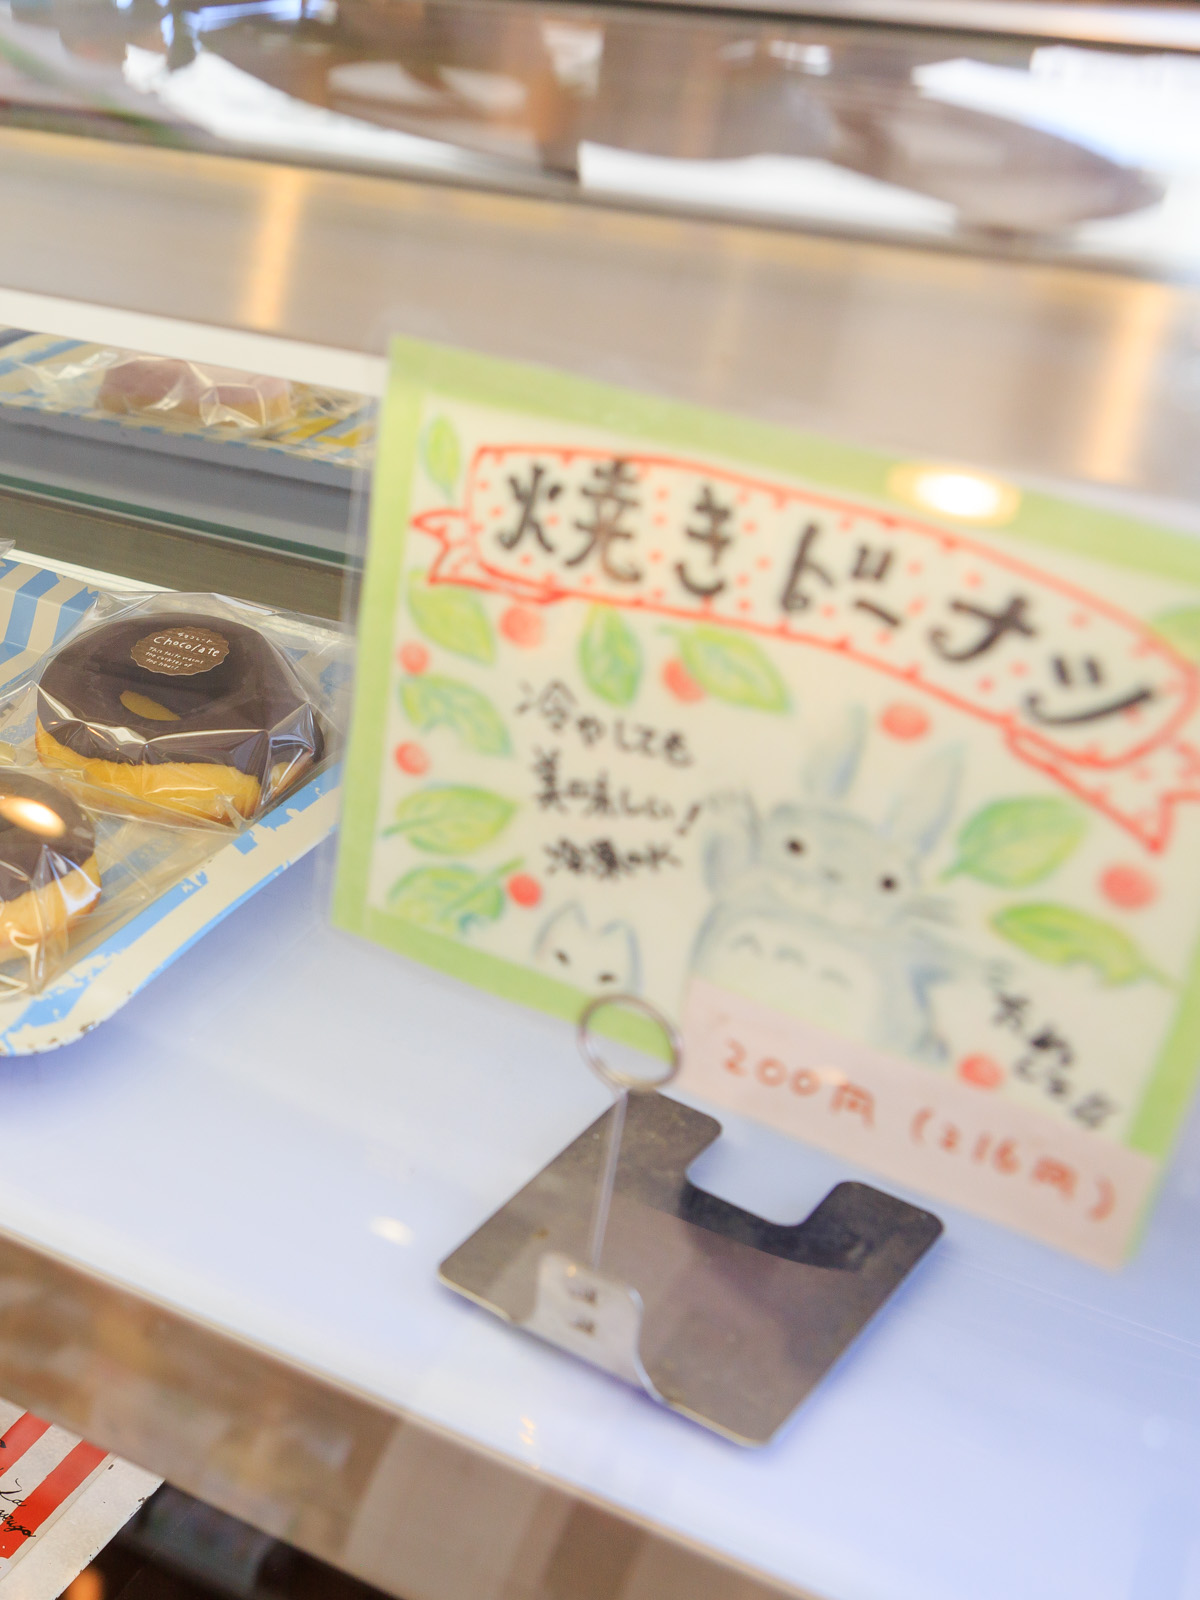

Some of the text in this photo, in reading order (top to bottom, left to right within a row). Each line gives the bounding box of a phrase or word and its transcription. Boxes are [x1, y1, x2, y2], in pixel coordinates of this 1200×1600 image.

[153, 636, 220, 657] Chocolate
[498, 458, 1156, 727] 焼きドーナツ
